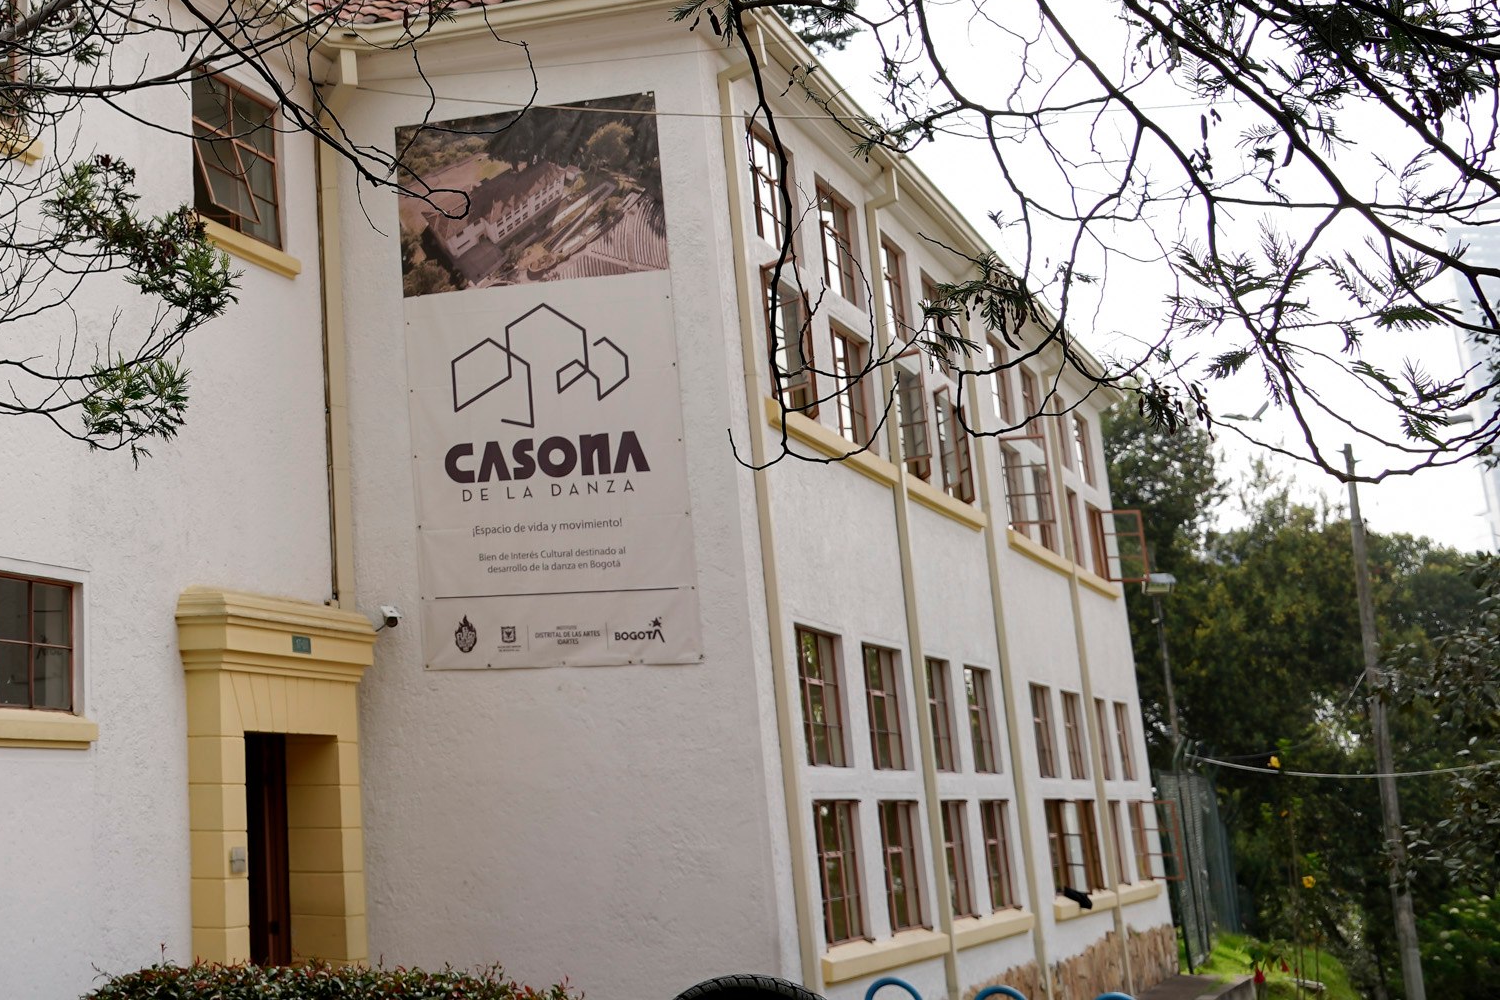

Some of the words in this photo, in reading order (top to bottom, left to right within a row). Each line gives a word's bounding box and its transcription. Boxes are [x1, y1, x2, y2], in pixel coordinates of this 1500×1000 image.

[445, 431, 651, 483] CASONA
[462, 488, 489, 502] DE
[506, 486, 533, 500] LA
[551, 480, 635, 497] DANZA
[472, 524, 512, 537] ¡Espacio
[513, 522, 526, 533] de
[528, 521, 549, 532] vida
[551, 524, 557, 534] y
[559, 518, 623, 531] movimiento!
[478, 553, 497, 562] Bien
[499, 552, 509, 561] de
[510, 550, 539, 560] Interés
[540, 549, 573, 559] Cultural
[575, 547, 616, 557] destinado
[618, 546, 626, 555] al
[487, 563, 528, 573] desarrollo
[529, 562, 540, 571] de
[542, 562, 550, 571] la
[551, 561, 576, 571] danza
[590, 559, 621, 570] Bogotá
